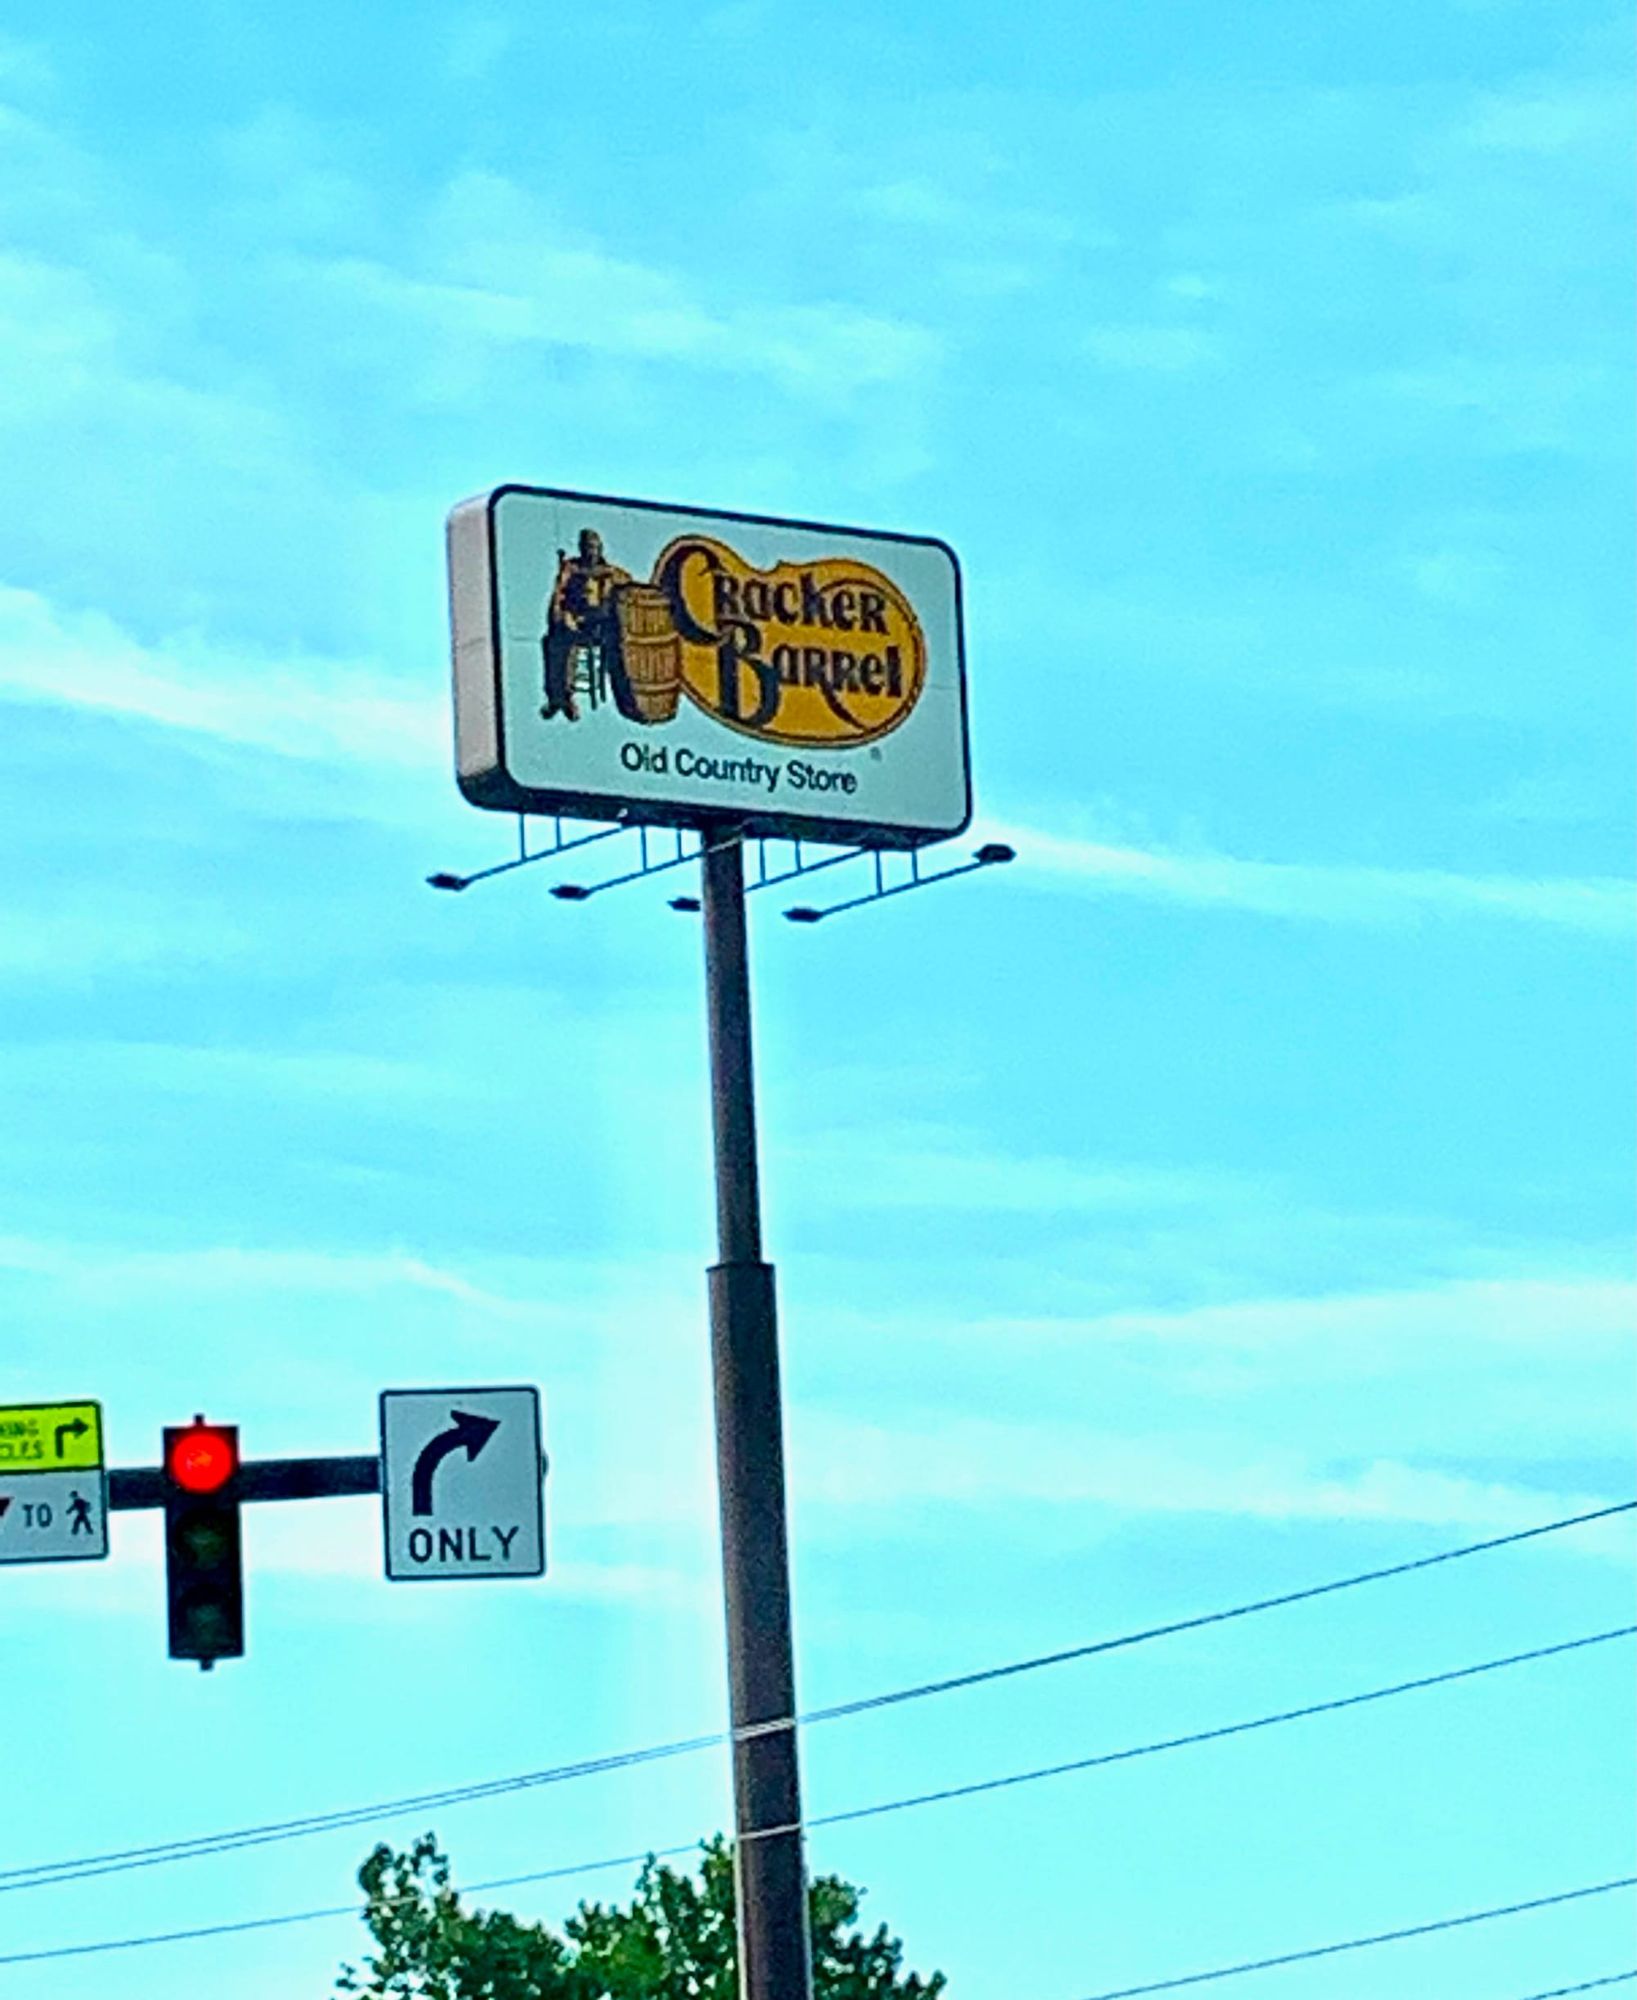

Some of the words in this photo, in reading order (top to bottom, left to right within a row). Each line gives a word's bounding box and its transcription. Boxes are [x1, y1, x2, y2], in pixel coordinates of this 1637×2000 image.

[659, 545, 890, 645] Cracker
[718, 619, 901, 729] Barrel
[620, 743, 668, 774] Old
[675, 748, 780, 793] Country
[787, 759, 858, 794] Store
[22, 1502, 53, 1528] TO
[408, 1525, 520, 1563] ONLY
